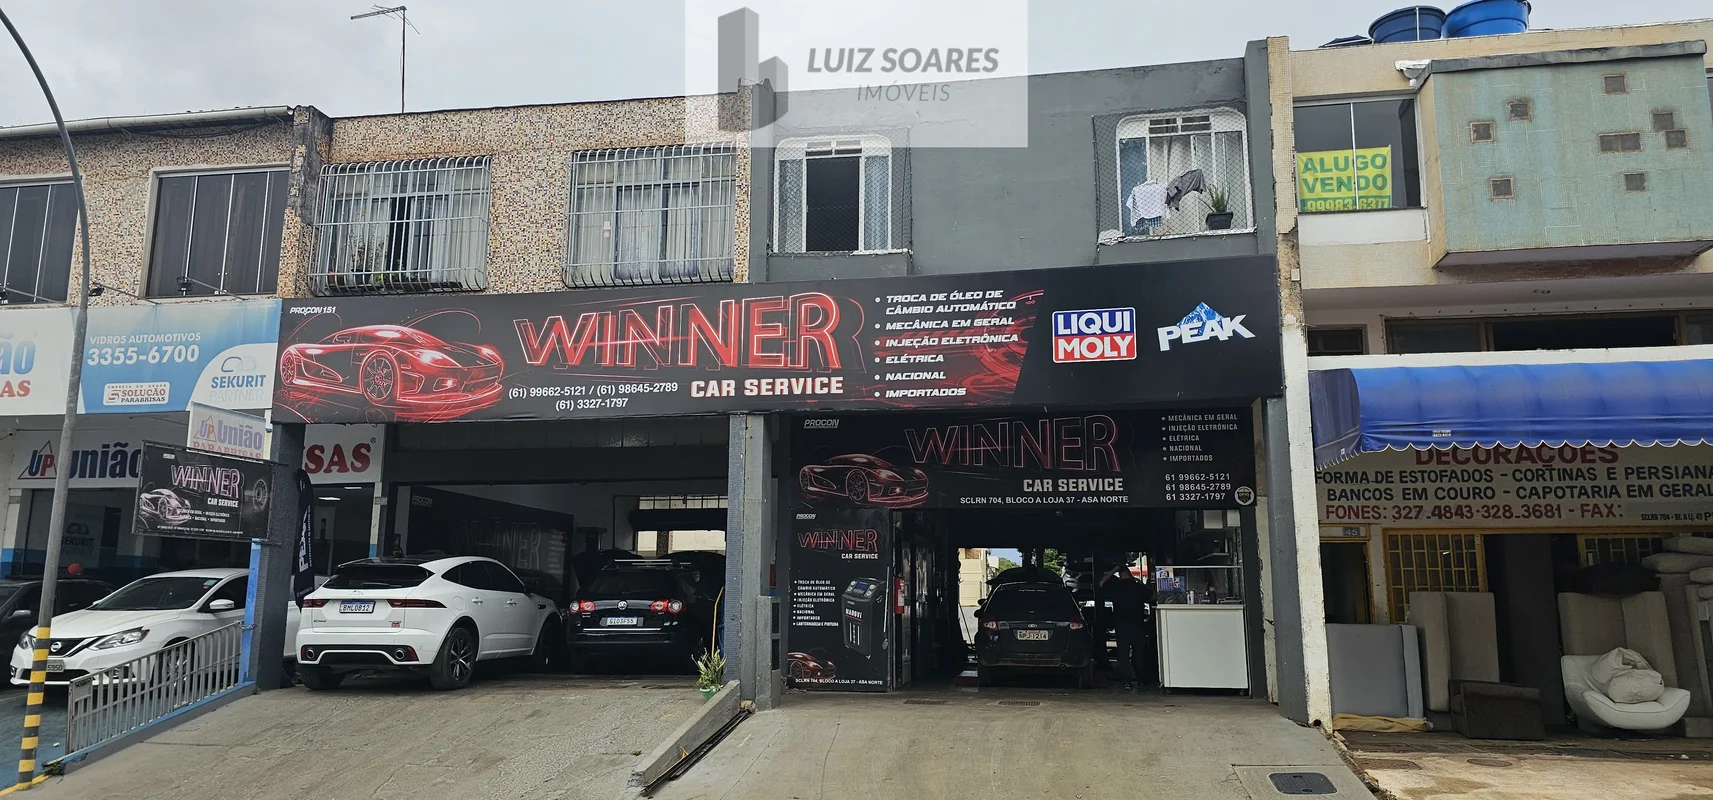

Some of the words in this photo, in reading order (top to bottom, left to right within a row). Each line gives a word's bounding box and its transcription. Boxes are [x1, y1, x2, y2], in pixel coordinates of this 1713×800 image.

[1302, 154, 1387, 174] ALUGO
[1302, 174, 1387, 194] VENDO
[886, 294, 927, 303] TROCA
[930, 293, 947, 301] DE
[950, 290, 983, 300] ÓLEO
[985, 290, 1003, 298] DE
[290, 306, 323, 314] PROCON
[886, 304, 933, 315] CÂMBIO
[936, 301, 1017, 312] AUTOMÁTICO
[886, 319, 949, 330] MECÂNICA
[951, 319, 971, 328] EM
[973, 317, 1015, 326] GERAL
[1057, 311, 1130, 335] LIQUI
[513, 292, 842, 370] WINNER
[1157, 314, 1256, 352] PEAK
[90, 335, 126, 344] VIDROS
[129, 333, 201, 344] AUTOMOTIVOS
[886, 336, 939, 348] INJEÇÃO
[941, 333, 1019, 345] ELETRÔNICA
[87, 344, 199, 365] 3355-6700
[1058, 336, 1133, 360] MOLY
[886, 354, 944, 364] ELÉTRICA
[211, 375, 266, 388] SEKURIT
[886, 371, 946, 381] NACIONAL
[121, 388, 166, 397] SOLUÇÃO
[509, 388, 527, 398] (61)
[530, 386, 586, 397] 99662-5121
[597, 385, 615, 395] (61)
[619, 382, 678, 394] 98645-2789
[690, 379, 736, 398] CAR
[744, 376, 844, 396] SERVICE
[886, 388, 967, 398] IMPORTADOS
[210, 388, 264, 402] PARTNER
[556, 400, 574, 411] (61)
[577, 398, 628, 409] 3327-1797
[804, 419, 839, 427] PROCON
[1168, 413, 1202, 421] MECÂNICA
[1168, 424, 1195, 432] INJEÇÃO
[1198, 423, 1238, 431] ELETRÔNICA
[217, 420, 263, 450] União
[905, 415, 1121, 472] WINNER
[304, 443, 371, 474] SAS
[170, 465, 240, 499] WINNER
[1178, 473, 1230, 481] 99662-5121
[1374, 471, 1394, 484] DE
[1399, 469, 1494, 483] ESTOFADOS
[1512, 467, 1597, 482] CORTINAS
[1607, 467, 1617, 480] E
[1023, 480, 1052, 492] CAR
[1058, 478, 1123, 491] SERVICE
[1179, 483, 1231, 491] 98645-2789
[1179, 493, 1226, 501] 3327-1797
[1327, 488, 1393, 501] BANCOS
[1402, 488, 1428, 500] EM
[1434, 486, 1495, 500] COURO
[1516, 485, 1621, 500] CAPOTARIA
[1626, 484, 1653, 498] EM
[207, 497, 217, 505] CAR
[218, 498, 238, 507] SERVICE
[988, 497, 1004, 505] 704,
[1006, 496, 1033, 504] BLOCO
[1043, 496, 1063, 504] LOJA
[1325, 504, 1387, 519] FONES:
[1580, 503, 1623, 518] FAX:
[798, 529, 878, 552] WINNER
